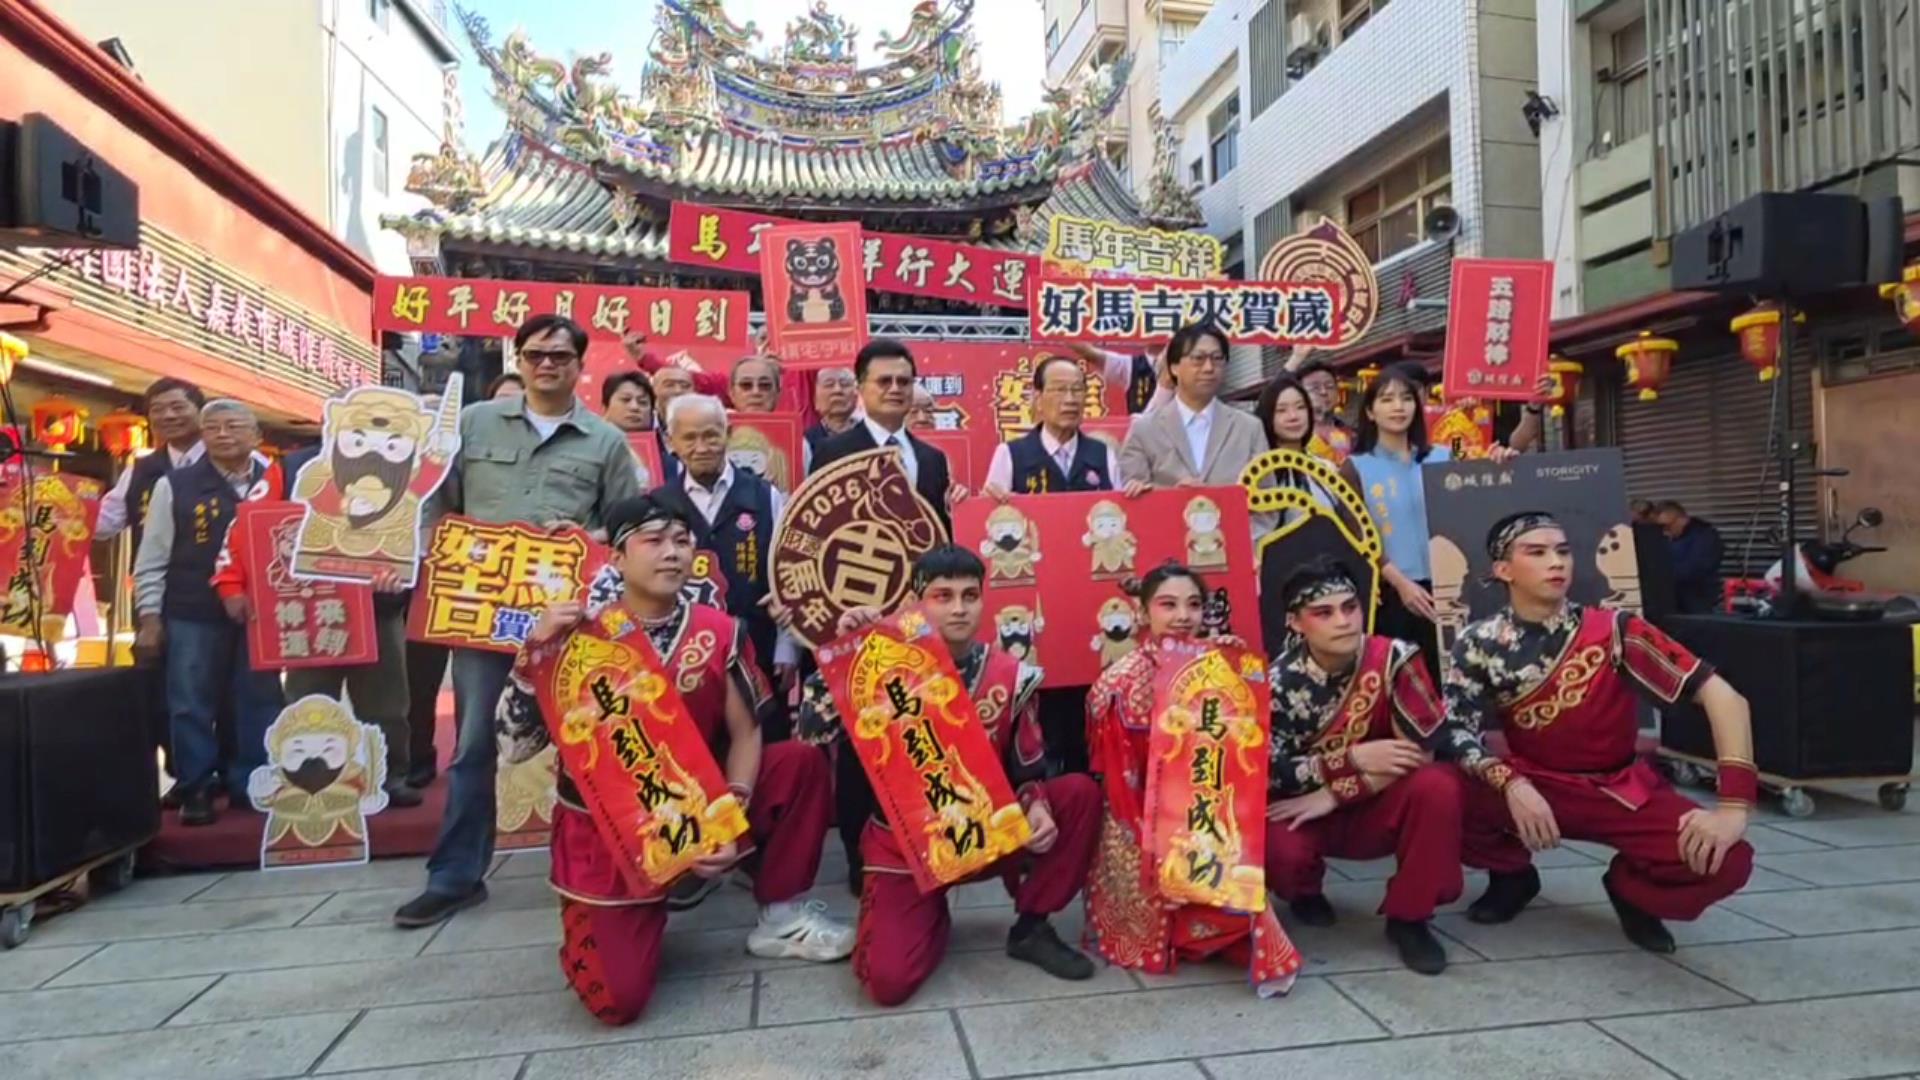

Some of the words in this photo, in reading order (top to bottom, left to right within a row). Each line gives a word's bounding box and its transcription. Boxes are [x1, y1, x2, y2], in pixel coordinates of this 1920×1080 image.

[692, 214, 1027, 301] 馬祥行大運
[1053, 219, 1216, 280] 馬年吉祥
[392, 283, 728, 342] 好年好月好日到
[1041, 284, 1333, 338] 好馬吉來賀歲
[801, 479, 862, 530] 2026
[830, 523, 903, 607] 吉
[590, 674, 701, 855] 馬到成功
[884, 675, 985, 857] 馬到成功
[1187, 696, 1228, 889] 馬到成功
